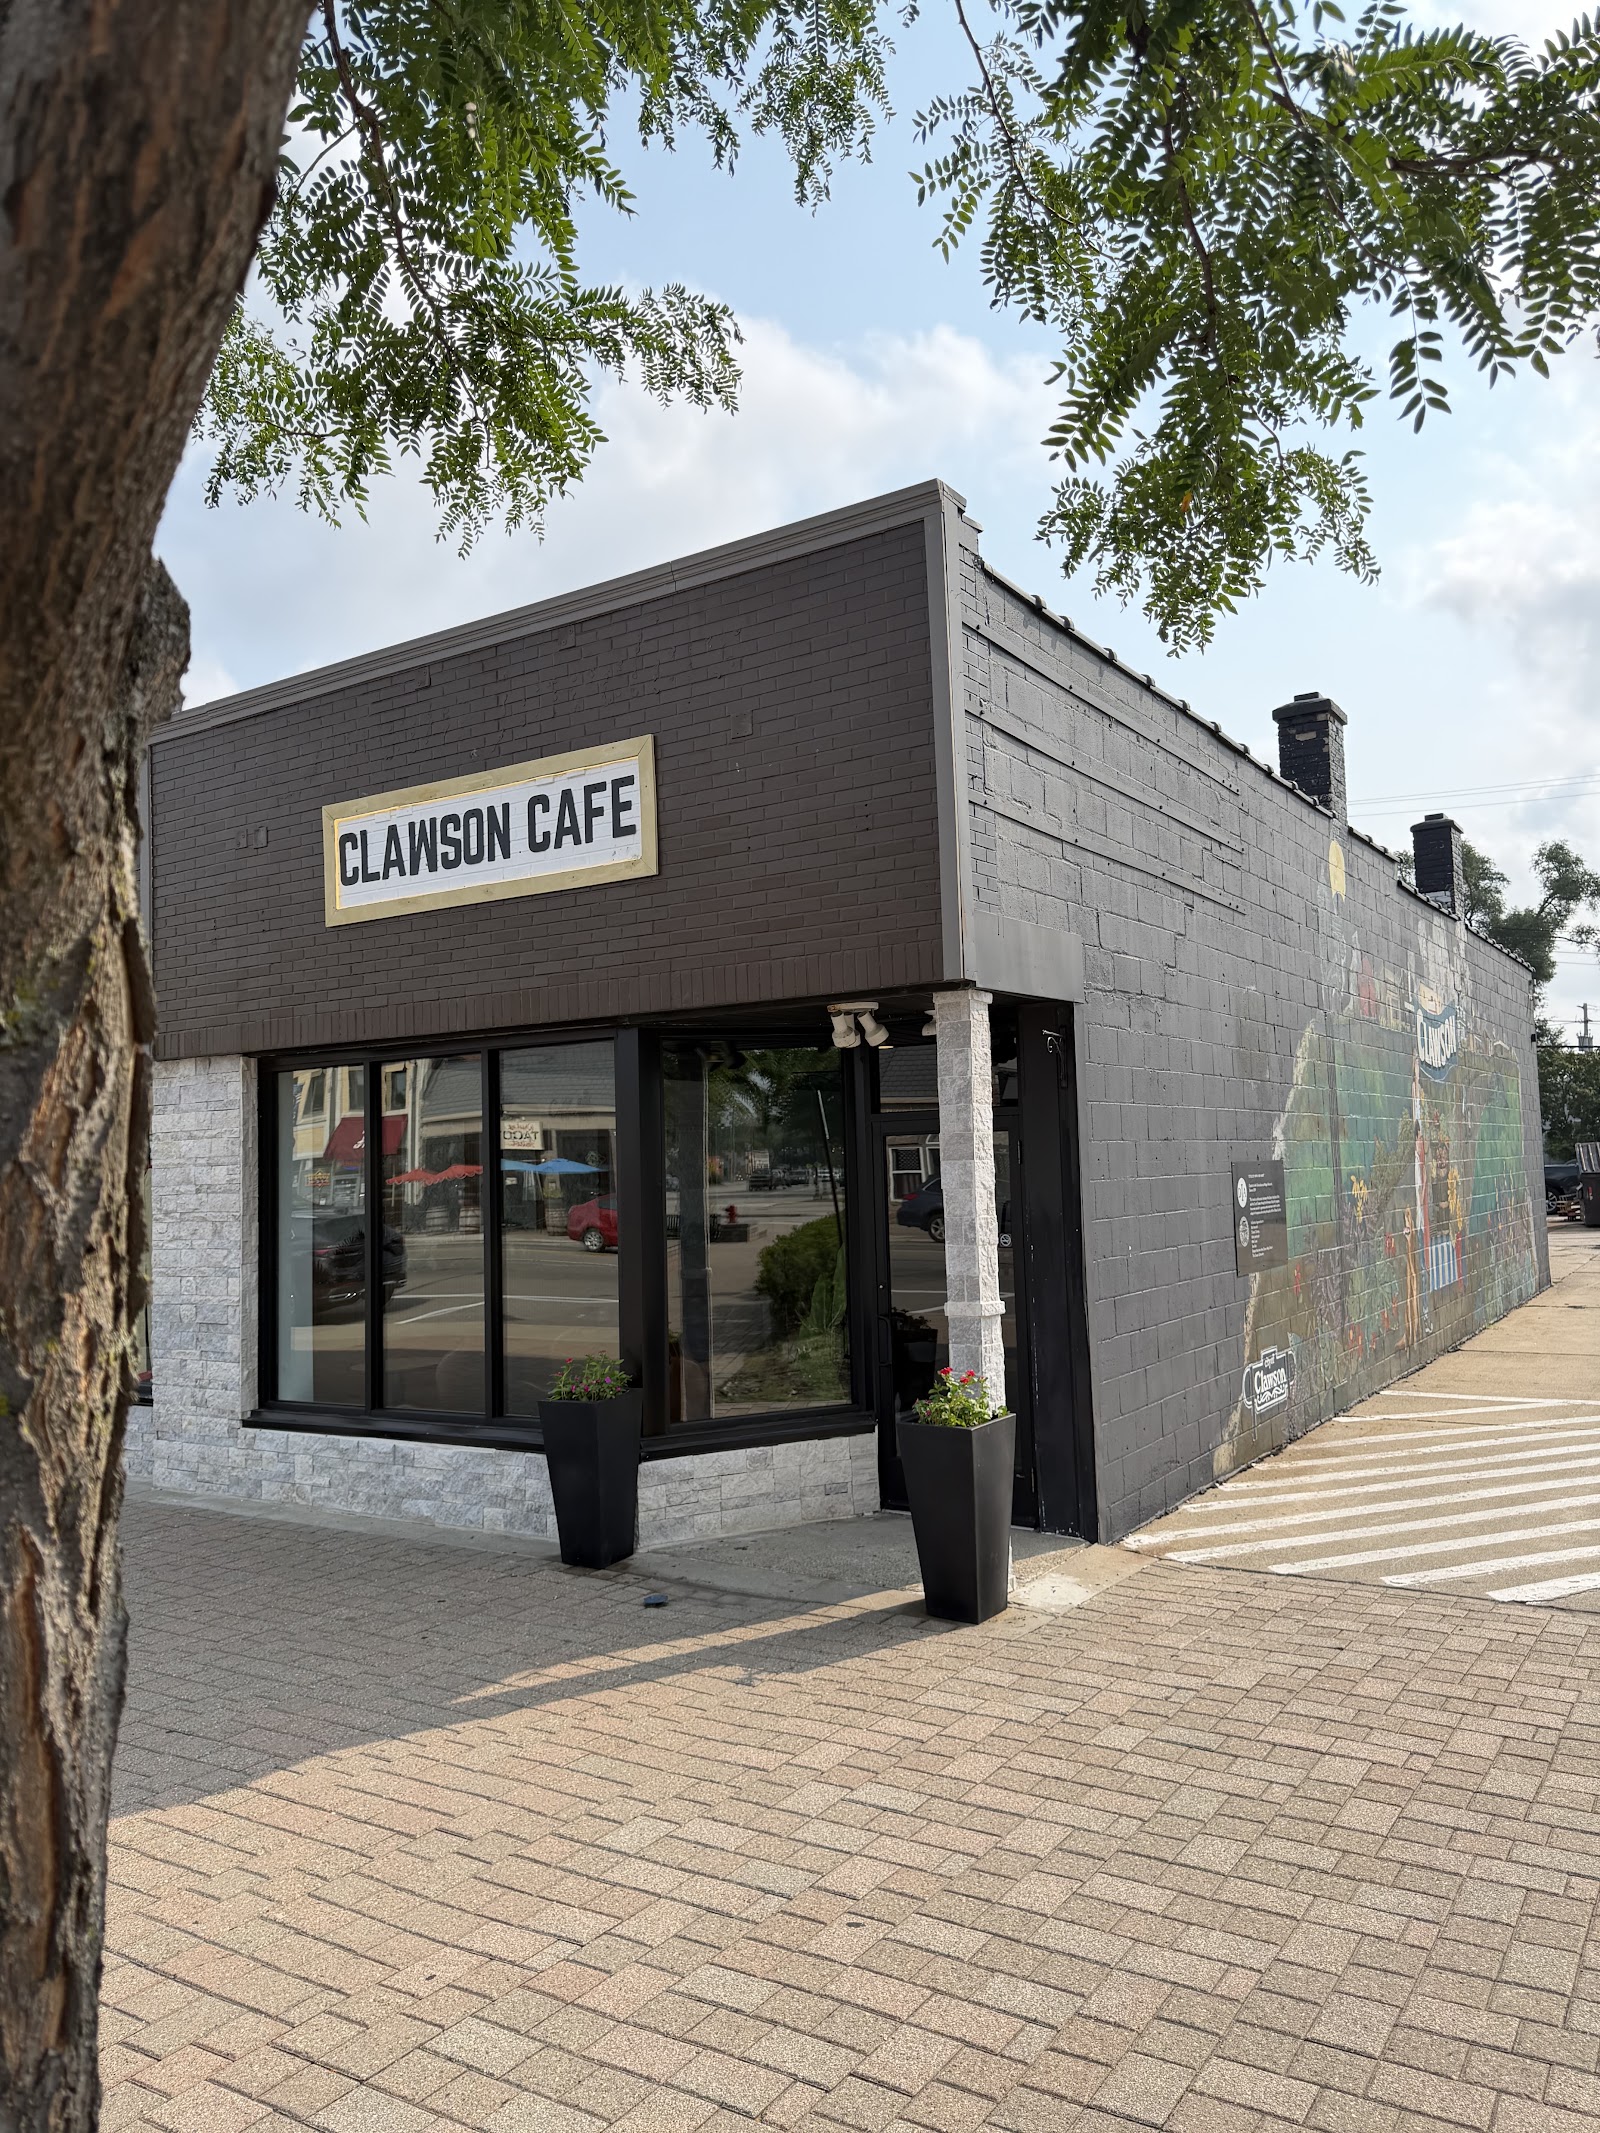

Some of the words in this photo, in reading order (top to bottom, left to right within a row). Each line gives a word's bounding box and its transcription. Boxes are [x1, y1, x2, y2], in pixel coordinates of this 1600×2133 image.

[338, 802, 511, 887] CLAWSON
[527, 774, 637, 853] CAFE
[1416, 1008, 1456, 1068] CLAWSON
[1254, 1367, 1287, 1394] Clawson
